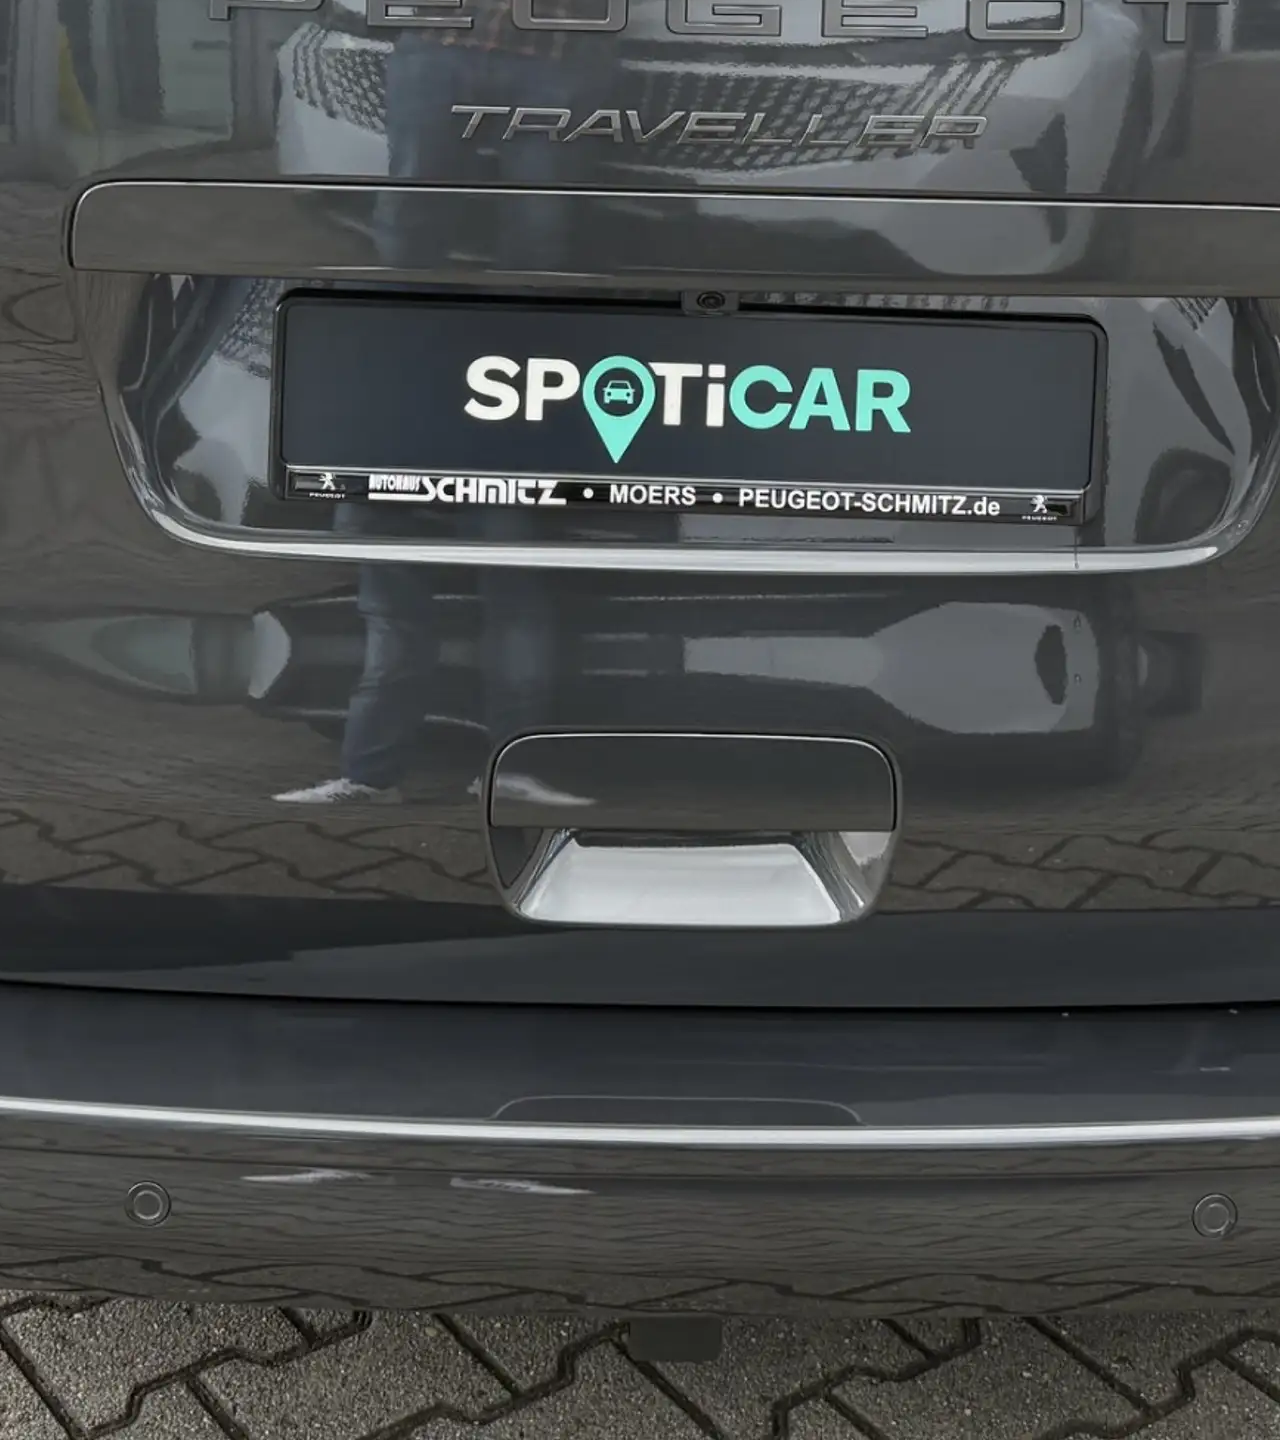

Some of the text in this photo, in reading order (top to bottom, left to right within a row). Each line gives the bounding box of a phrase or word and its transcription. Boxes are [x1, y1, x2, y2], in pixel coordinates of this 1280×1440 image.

[451, 104, 988, 150] TRAVELLER
[369, 472, 1000, 517] AUTOHAUS SCHMITZ MOERS PEUGEOT-SCHMITZ.de
